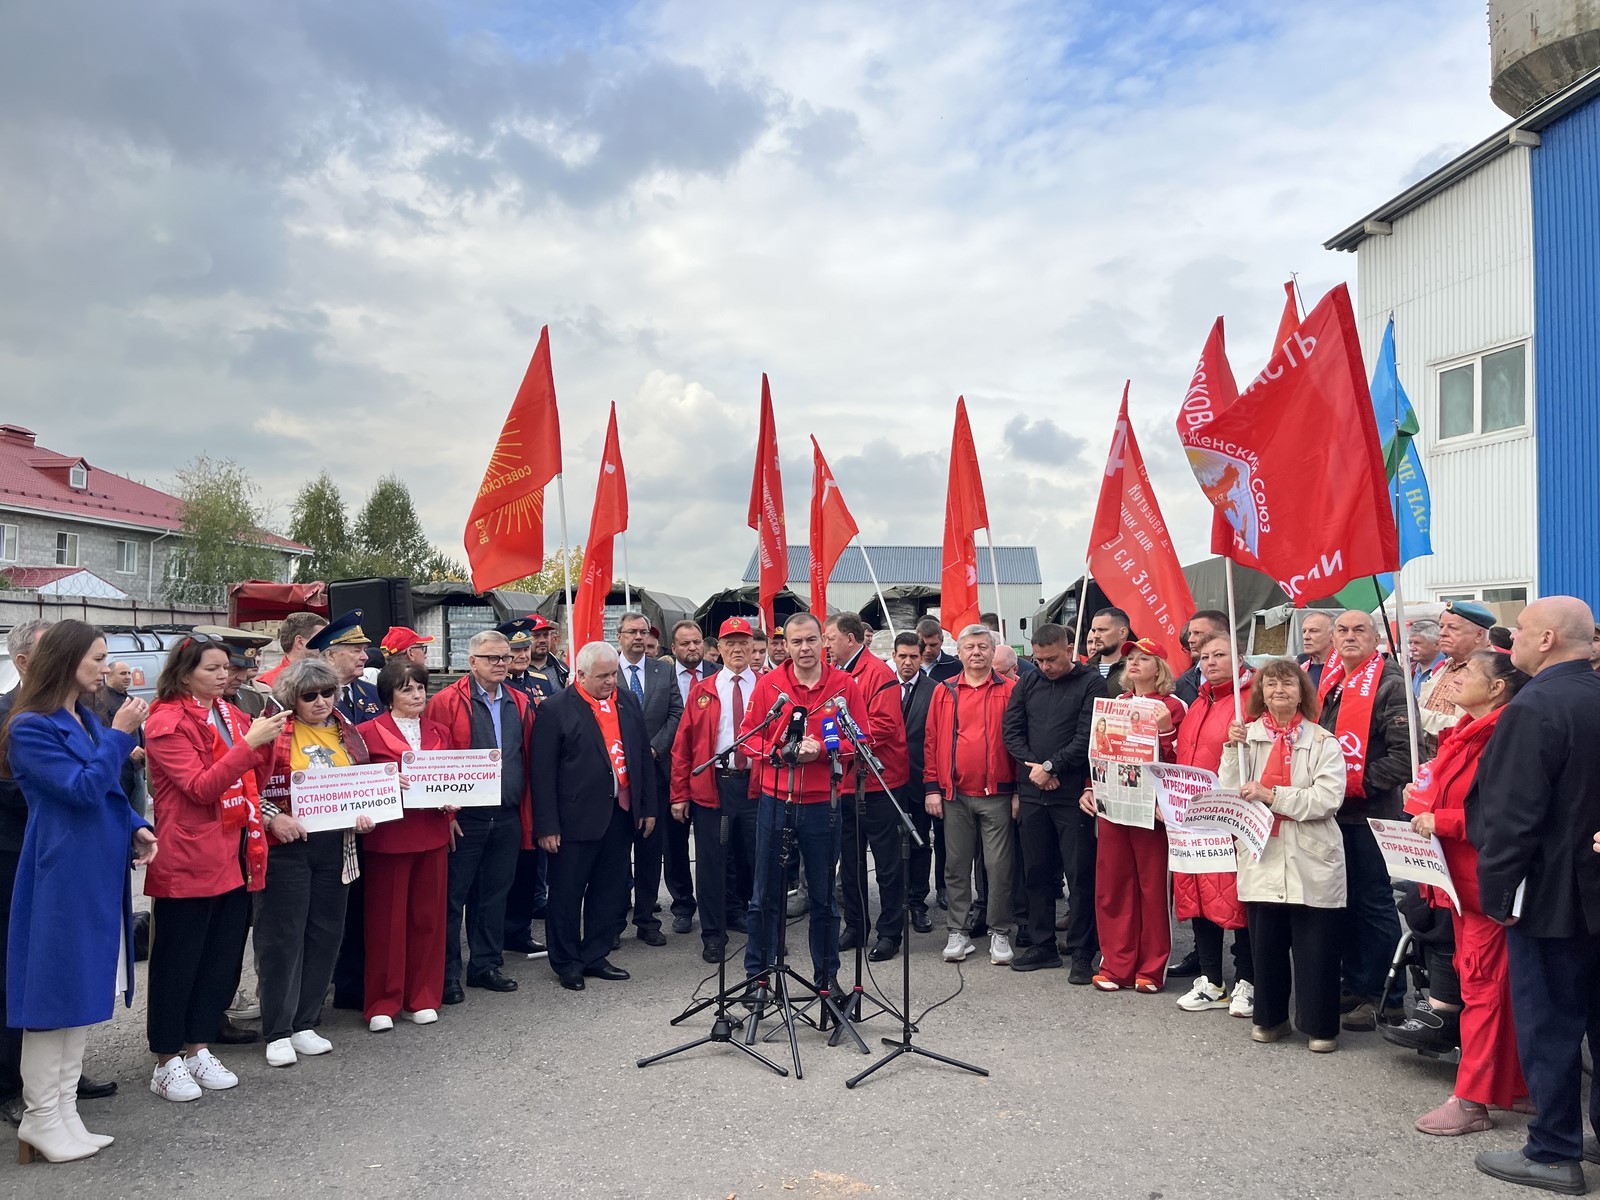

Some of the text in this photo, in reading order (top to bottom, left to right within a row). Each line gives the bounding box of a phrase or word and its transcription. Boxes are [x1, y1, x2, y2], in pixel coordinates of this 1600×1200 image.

[406, 773, 455, 782] БОГАТСТВА
[458, 772, 496, 780] РОССИИ
[1164, 768, 1212, 784] МЫ ПРОТИВ
[426, 783, 475, 793] НАРОДУ
[1162, 779, 1212, 795] АГРЕССИВНОЙ
[297, 786, 396, 804] ОСТАНОВИМ РОСТ ЦЕН,
[298, 796, 397, 817] ДОЛГОВ И ТАРИФОВ
[1188, 806, 1264, 841] ГОРОДАМ И СЕЛАМ
[1216, 815, 1239, 828] МЕСТА
[1203, 837, 1232, 846] ТОВАР,
[1208, 848, 1234, 857] БАЗАР
[1404, 856, 1411, 864] А
[1413, 858, 1426, 868] НЕ
